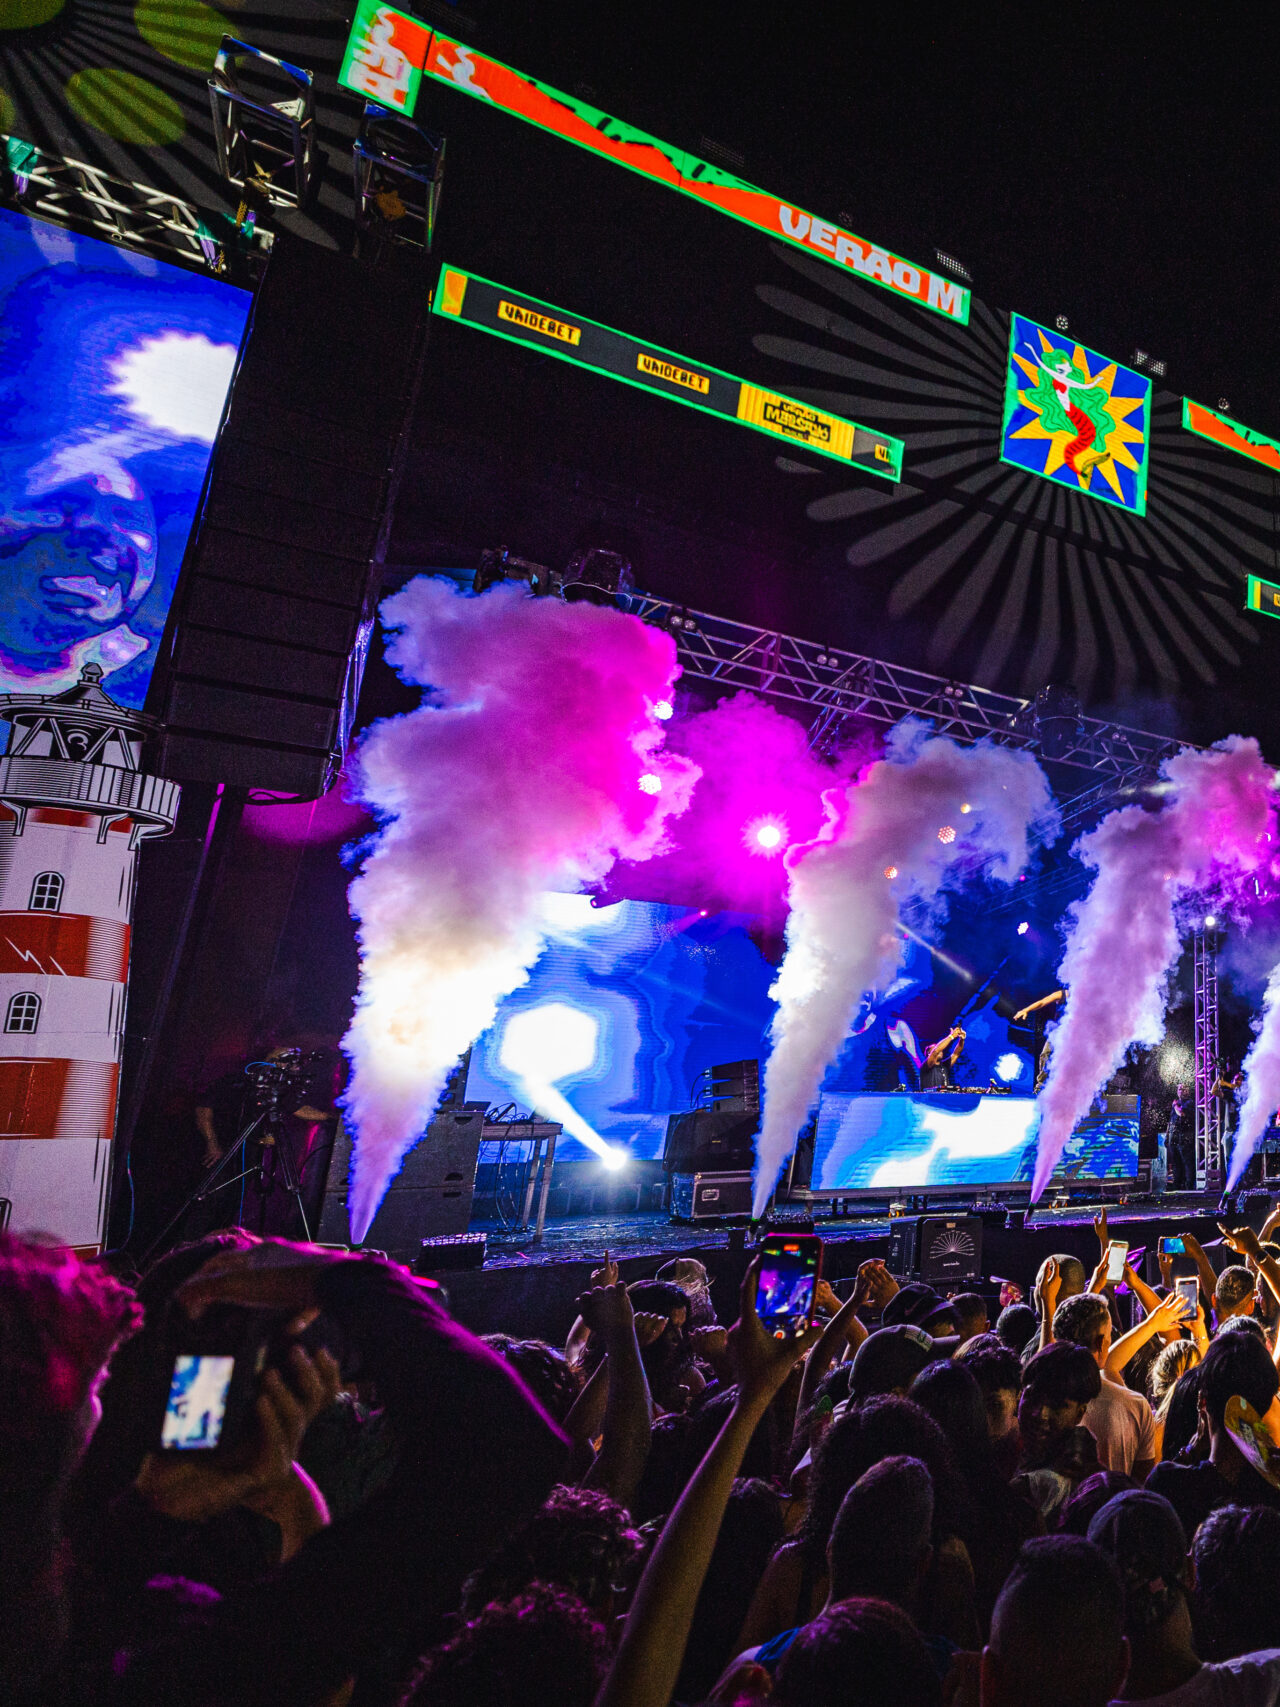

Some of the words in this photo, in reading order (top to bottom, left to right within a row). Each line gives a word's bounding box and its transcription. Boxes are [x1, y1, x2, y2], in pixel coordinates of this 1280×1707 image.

[779, 205, 921, 294] VERÃO
[504, 304, 575, 340] VAIDEBET
[643, 357, 705, 390] VAIDEBET
